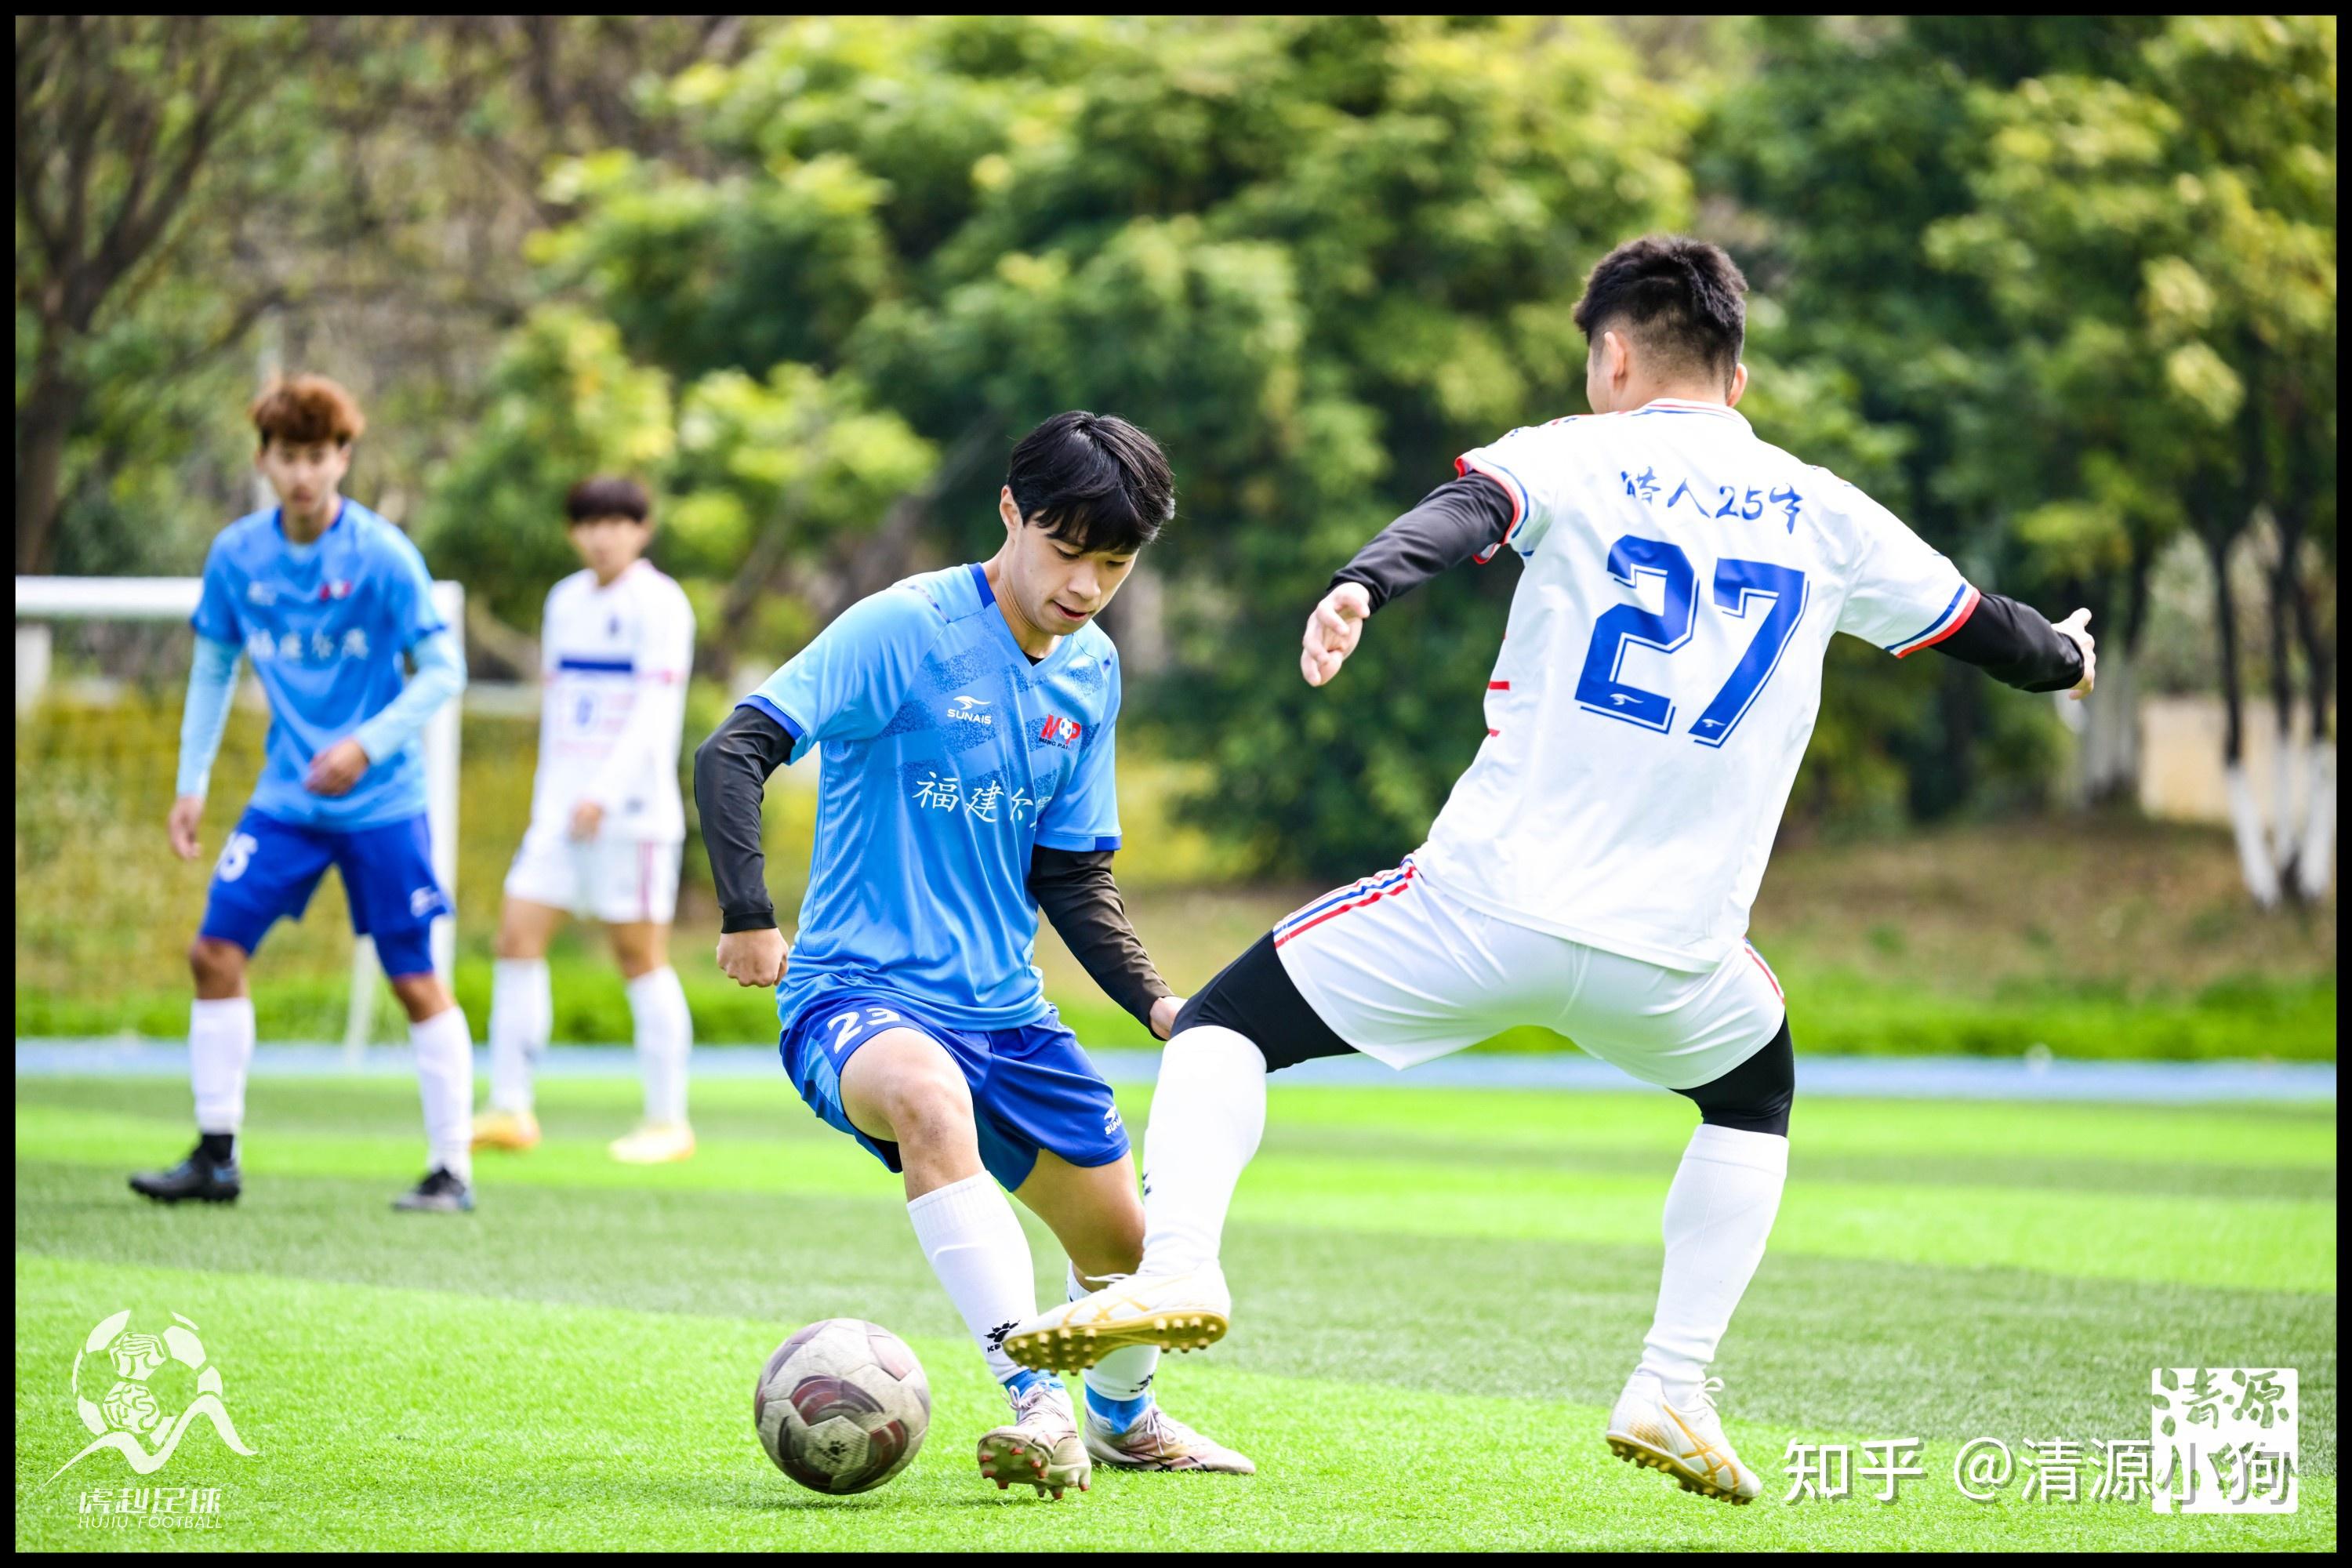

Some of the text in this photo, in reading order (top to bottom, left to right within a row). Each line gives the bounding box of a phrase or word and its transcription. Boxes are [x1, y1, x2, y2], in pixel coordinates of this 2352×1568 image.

[1574, 534, 1809, 749] 27
[946, 708, 992, 725] SUNAIS
[827, 1007, 900, 1054] 23
